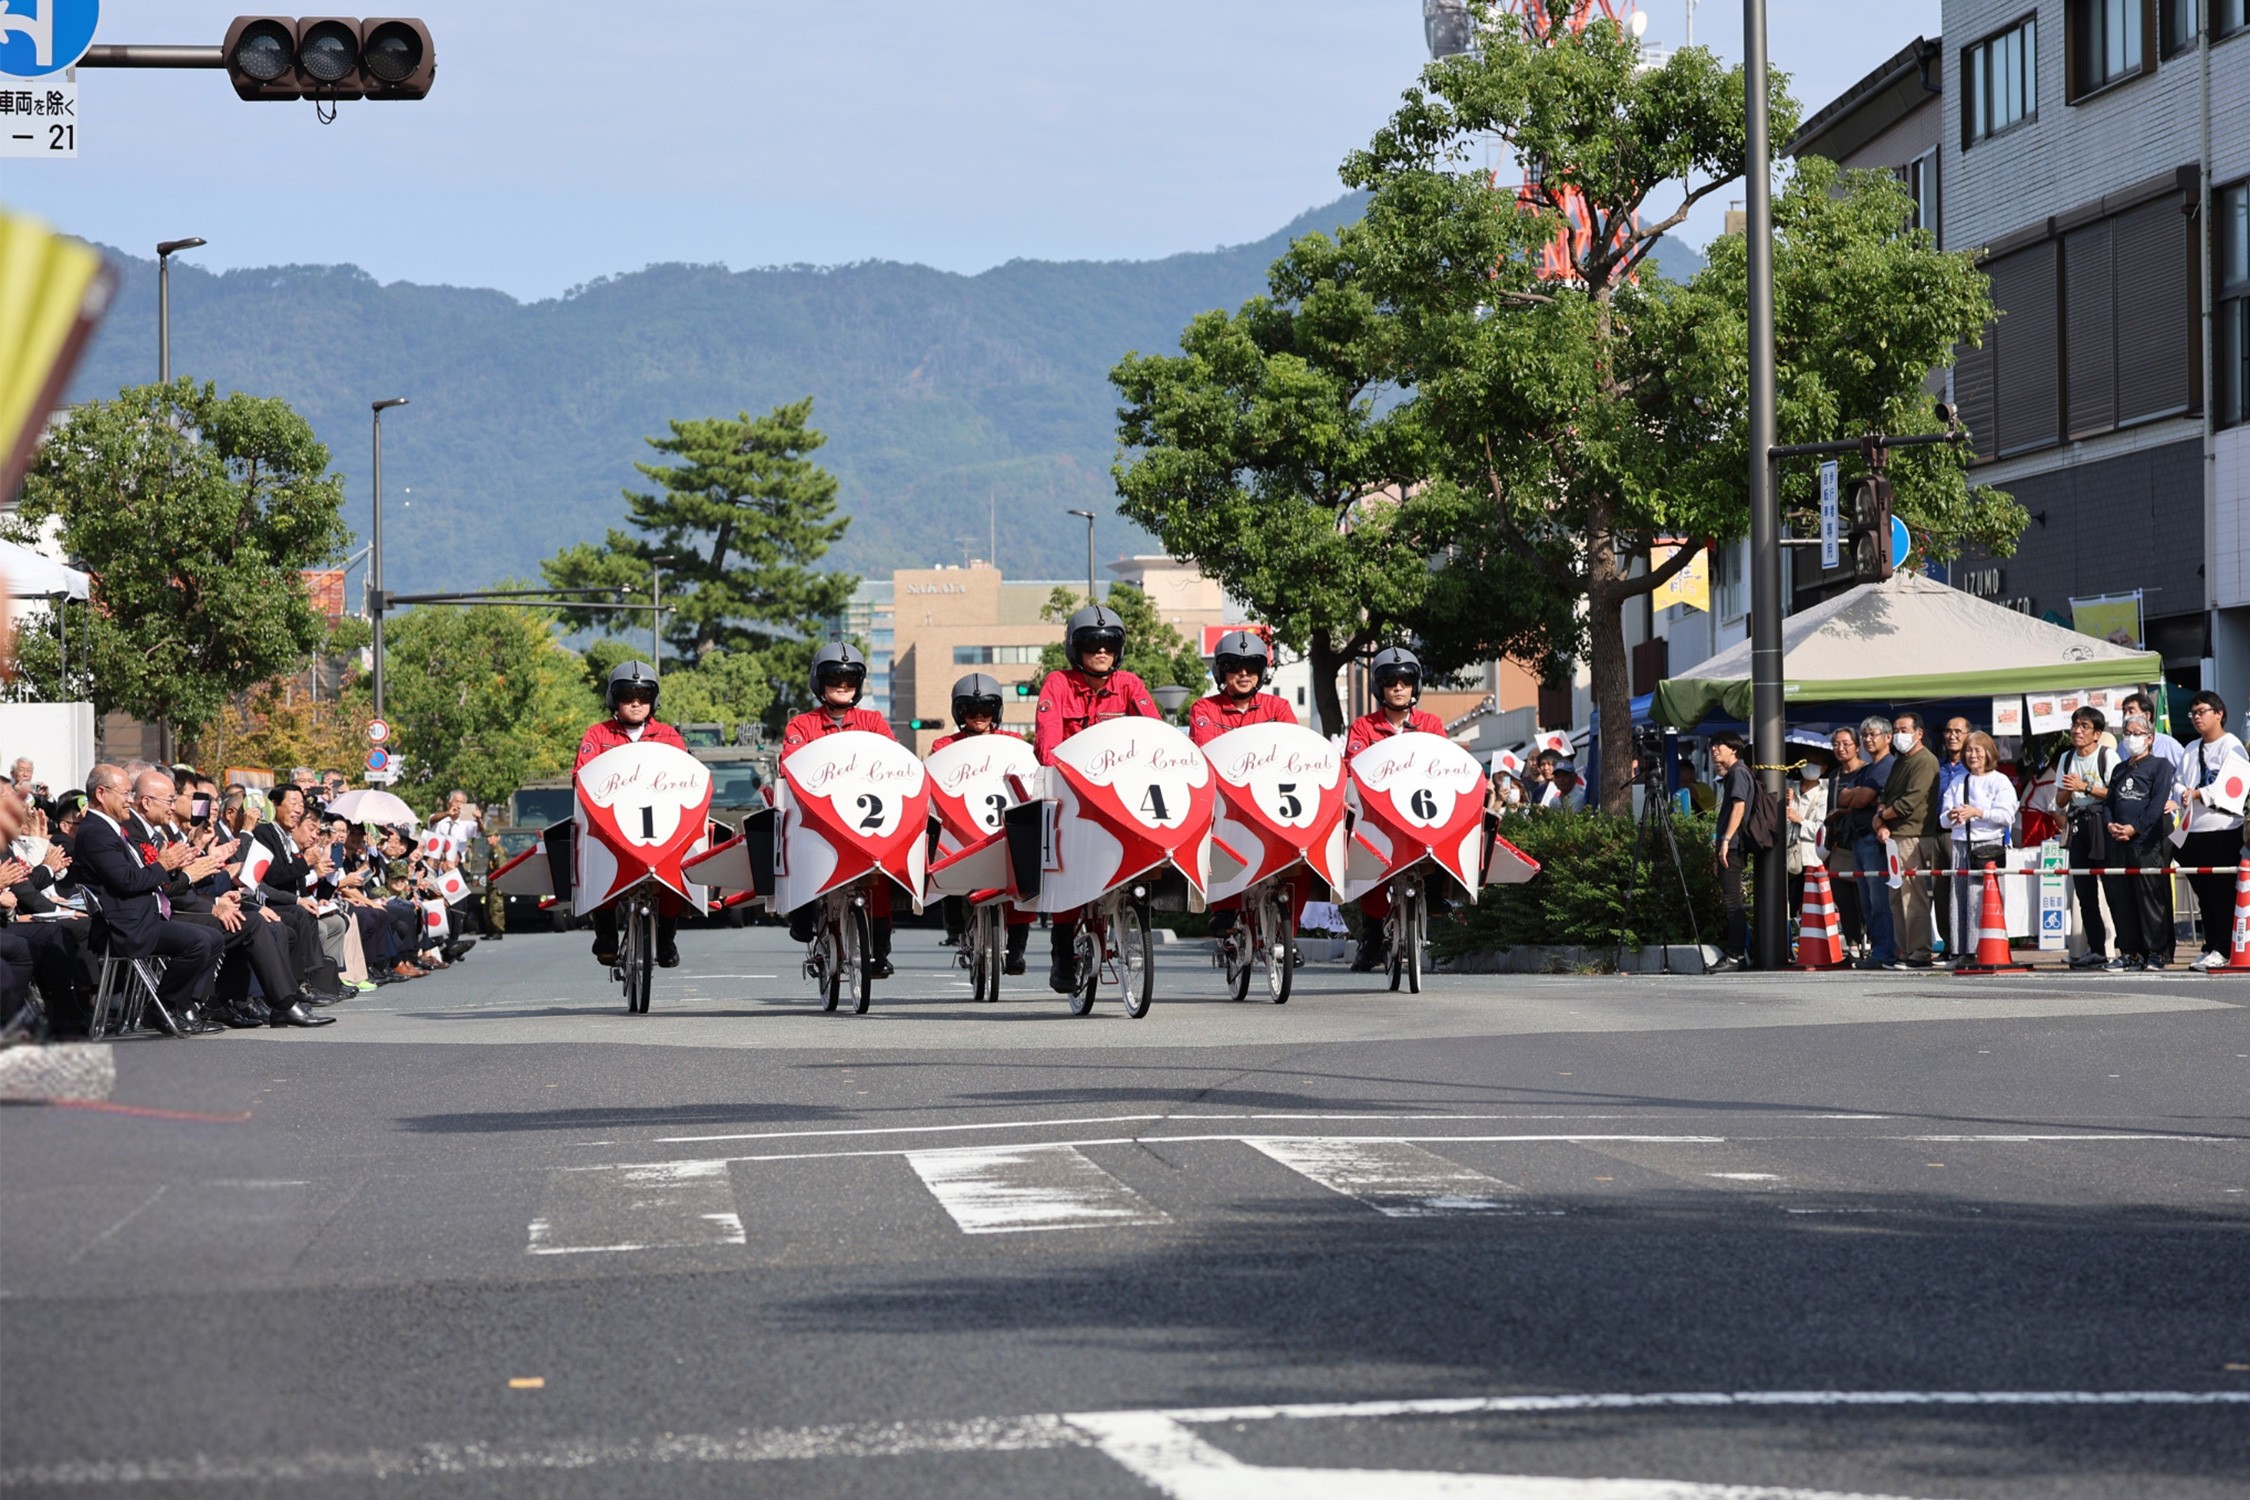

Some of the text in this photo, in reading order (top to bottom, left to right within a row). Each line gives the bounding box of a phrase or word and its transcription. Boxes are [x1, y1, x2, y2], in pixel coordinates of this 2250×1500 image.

[0, 90, 75, 116] 車両を除く
[49, 124, 74, 150] 21
[1963, 567, 2000, 597] IZUMO
[806, 752, 918, 792] Red Crab
[943, 754, 992, 791] Red
[1085, 738, 1200, 780] Red Crab
[1227, 743, 1333, 782] Red Crab
[1368, 751, 1472, 787] Red Crab
[594, 763, 702, 802] Red Crab
[1278, 783, 1302, 818] 5
[856, 793, 885, 829] 2
[985, 794, 1007, 827] 3
[1140, 784, 1172, 820] 4
[1411, 788, 1438, 820] 6
[638, 805, 658, 839] 1
